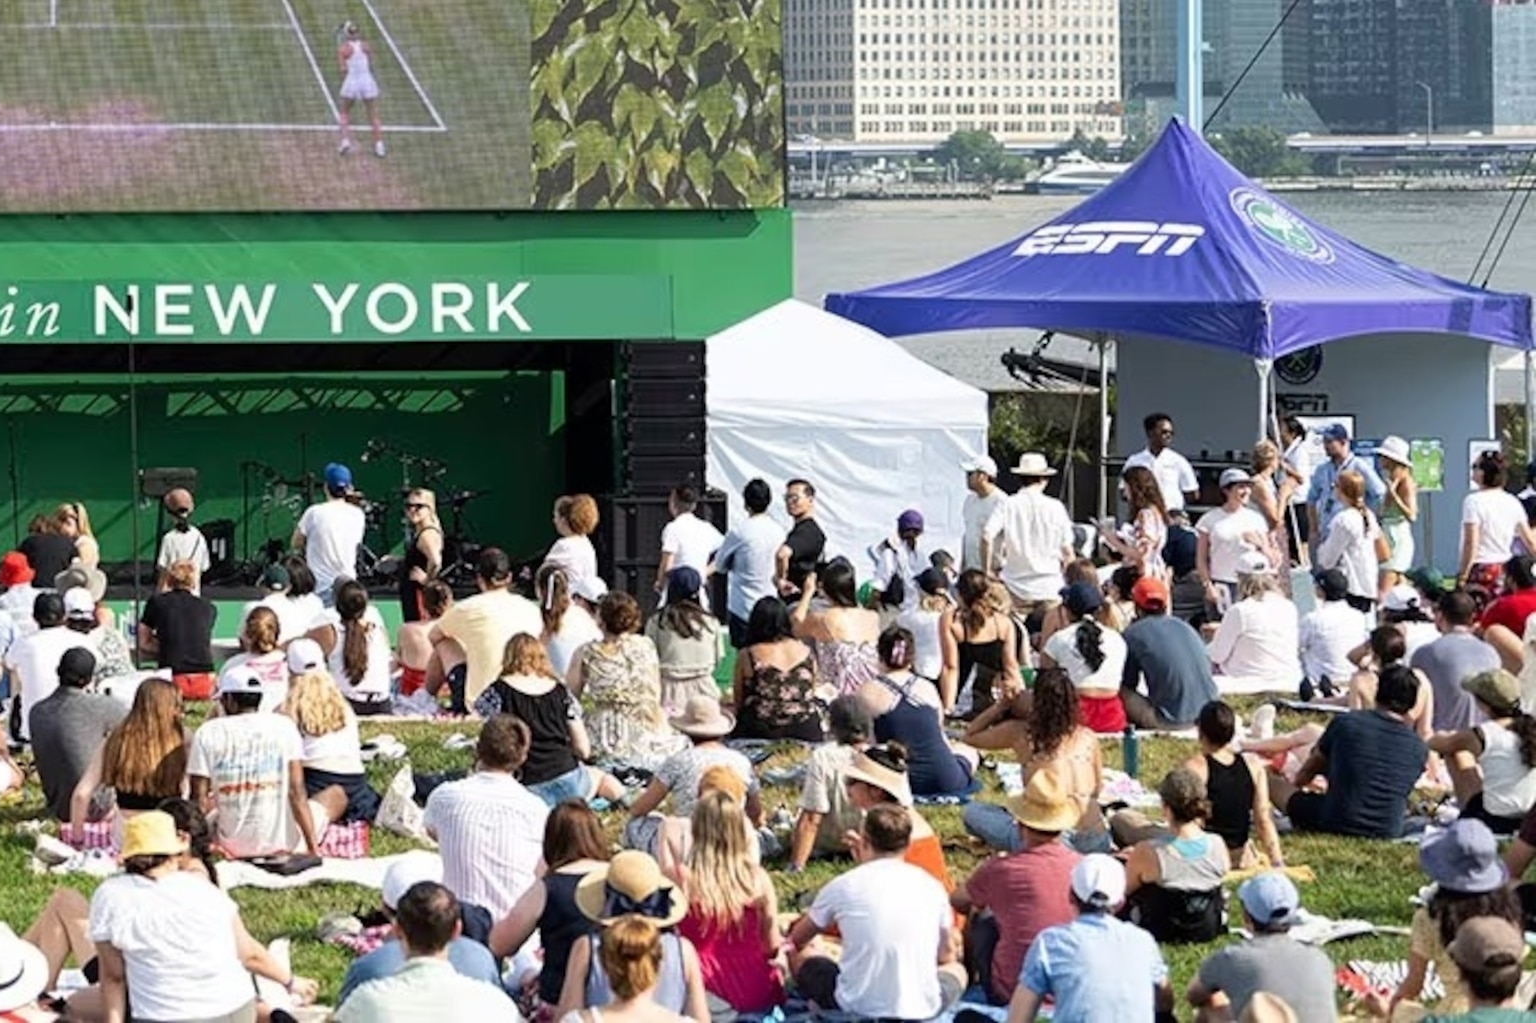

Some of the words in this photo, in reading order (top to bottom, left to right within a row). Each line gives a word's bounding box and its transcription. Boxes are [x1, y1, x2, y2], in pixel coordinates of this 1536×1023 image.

[1010, 220, 1206, 257] ESPN
[94, 284, 277, 335] NEW
[312, 281, 532, 334] YORK
